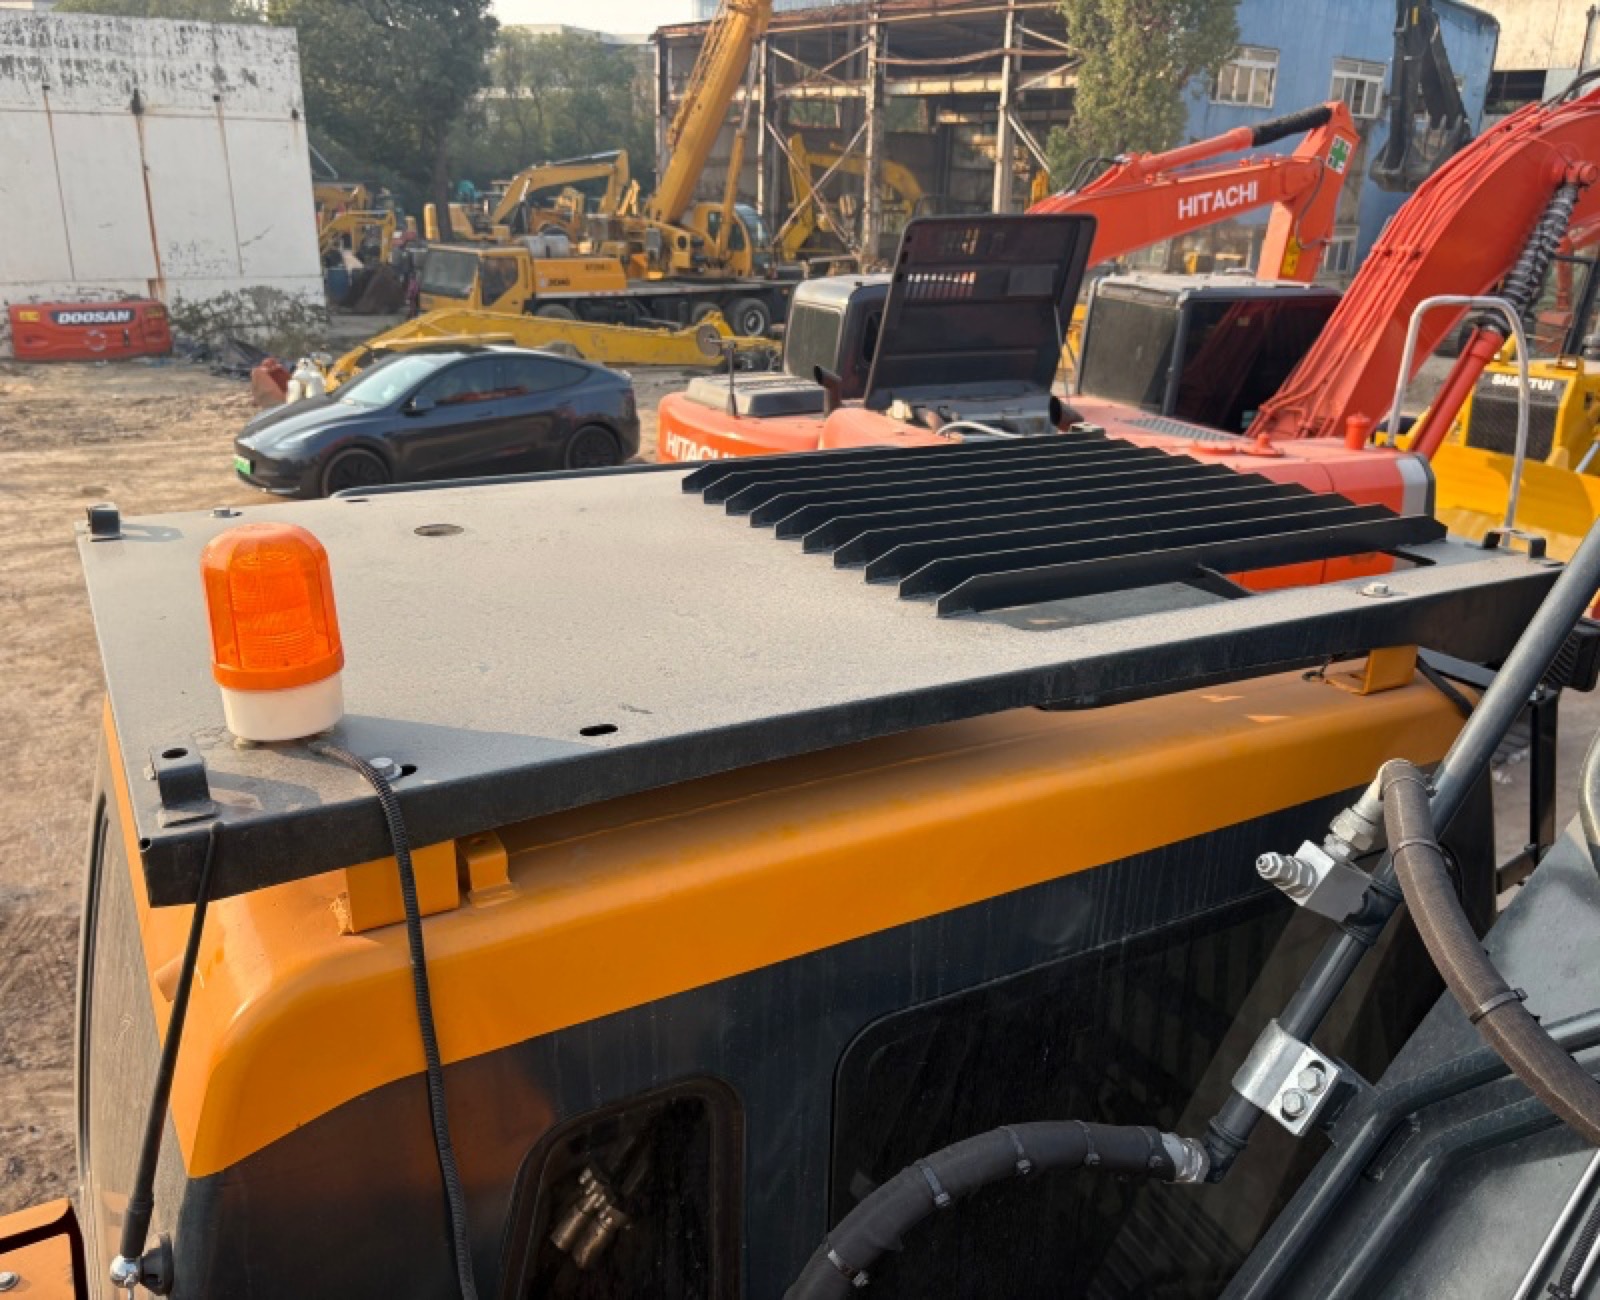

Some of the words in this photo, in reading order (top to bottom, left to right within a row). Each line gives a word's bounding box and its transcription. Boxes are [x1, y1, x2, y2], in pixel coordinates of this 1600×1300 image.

[1178, 181, 1258, 220] HITACHI
[57, 310, 131, 325] DOOSAN
[1492, 373, 1555, 391] SHATUI
